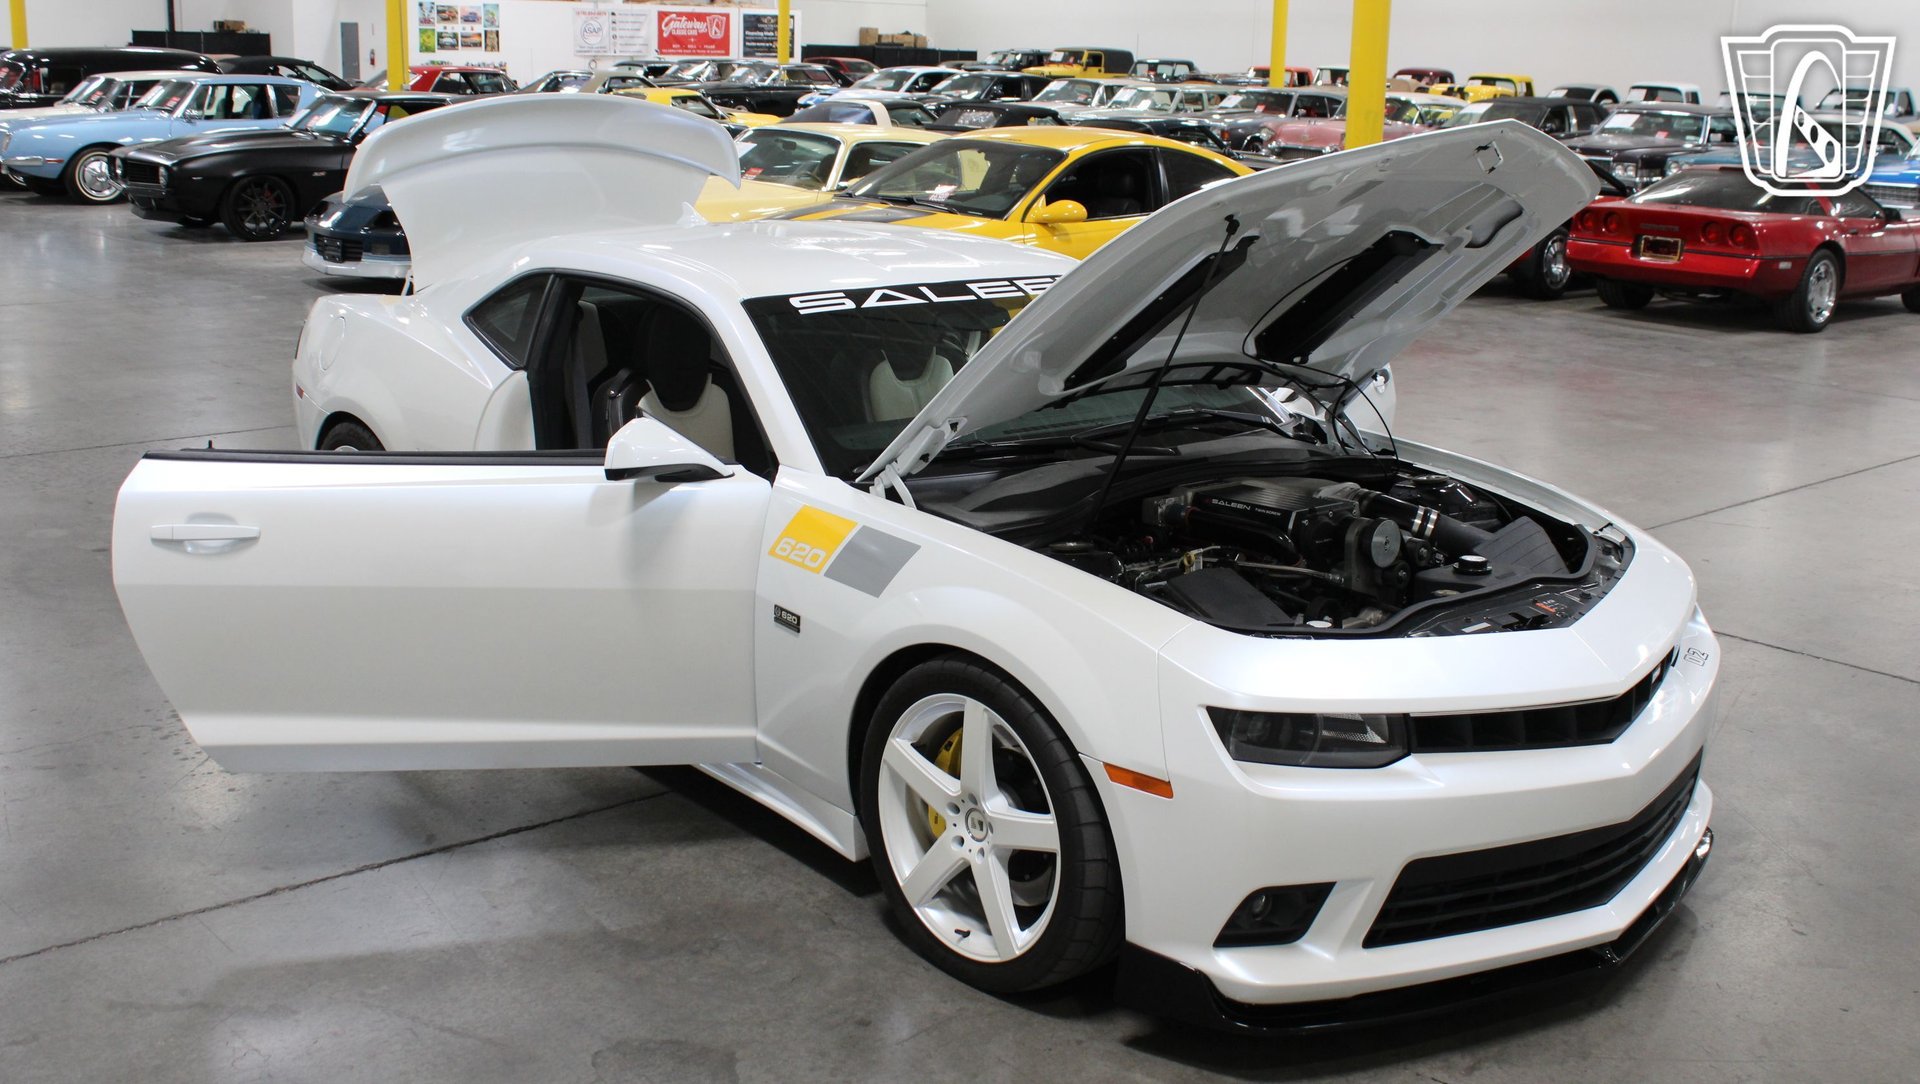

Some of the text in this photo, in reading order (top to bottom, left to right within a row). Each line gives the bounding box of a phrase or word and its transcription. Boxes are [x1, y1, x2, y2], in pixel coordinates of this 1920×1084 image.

[661, 13, 708, 38] Gateway
[789, 275, 1059, 315] SALEE
[1211, 498, 1251, 511] SALEEN
[775, 537, 826, 568] 620
[781, 610, 798, 625] 620
